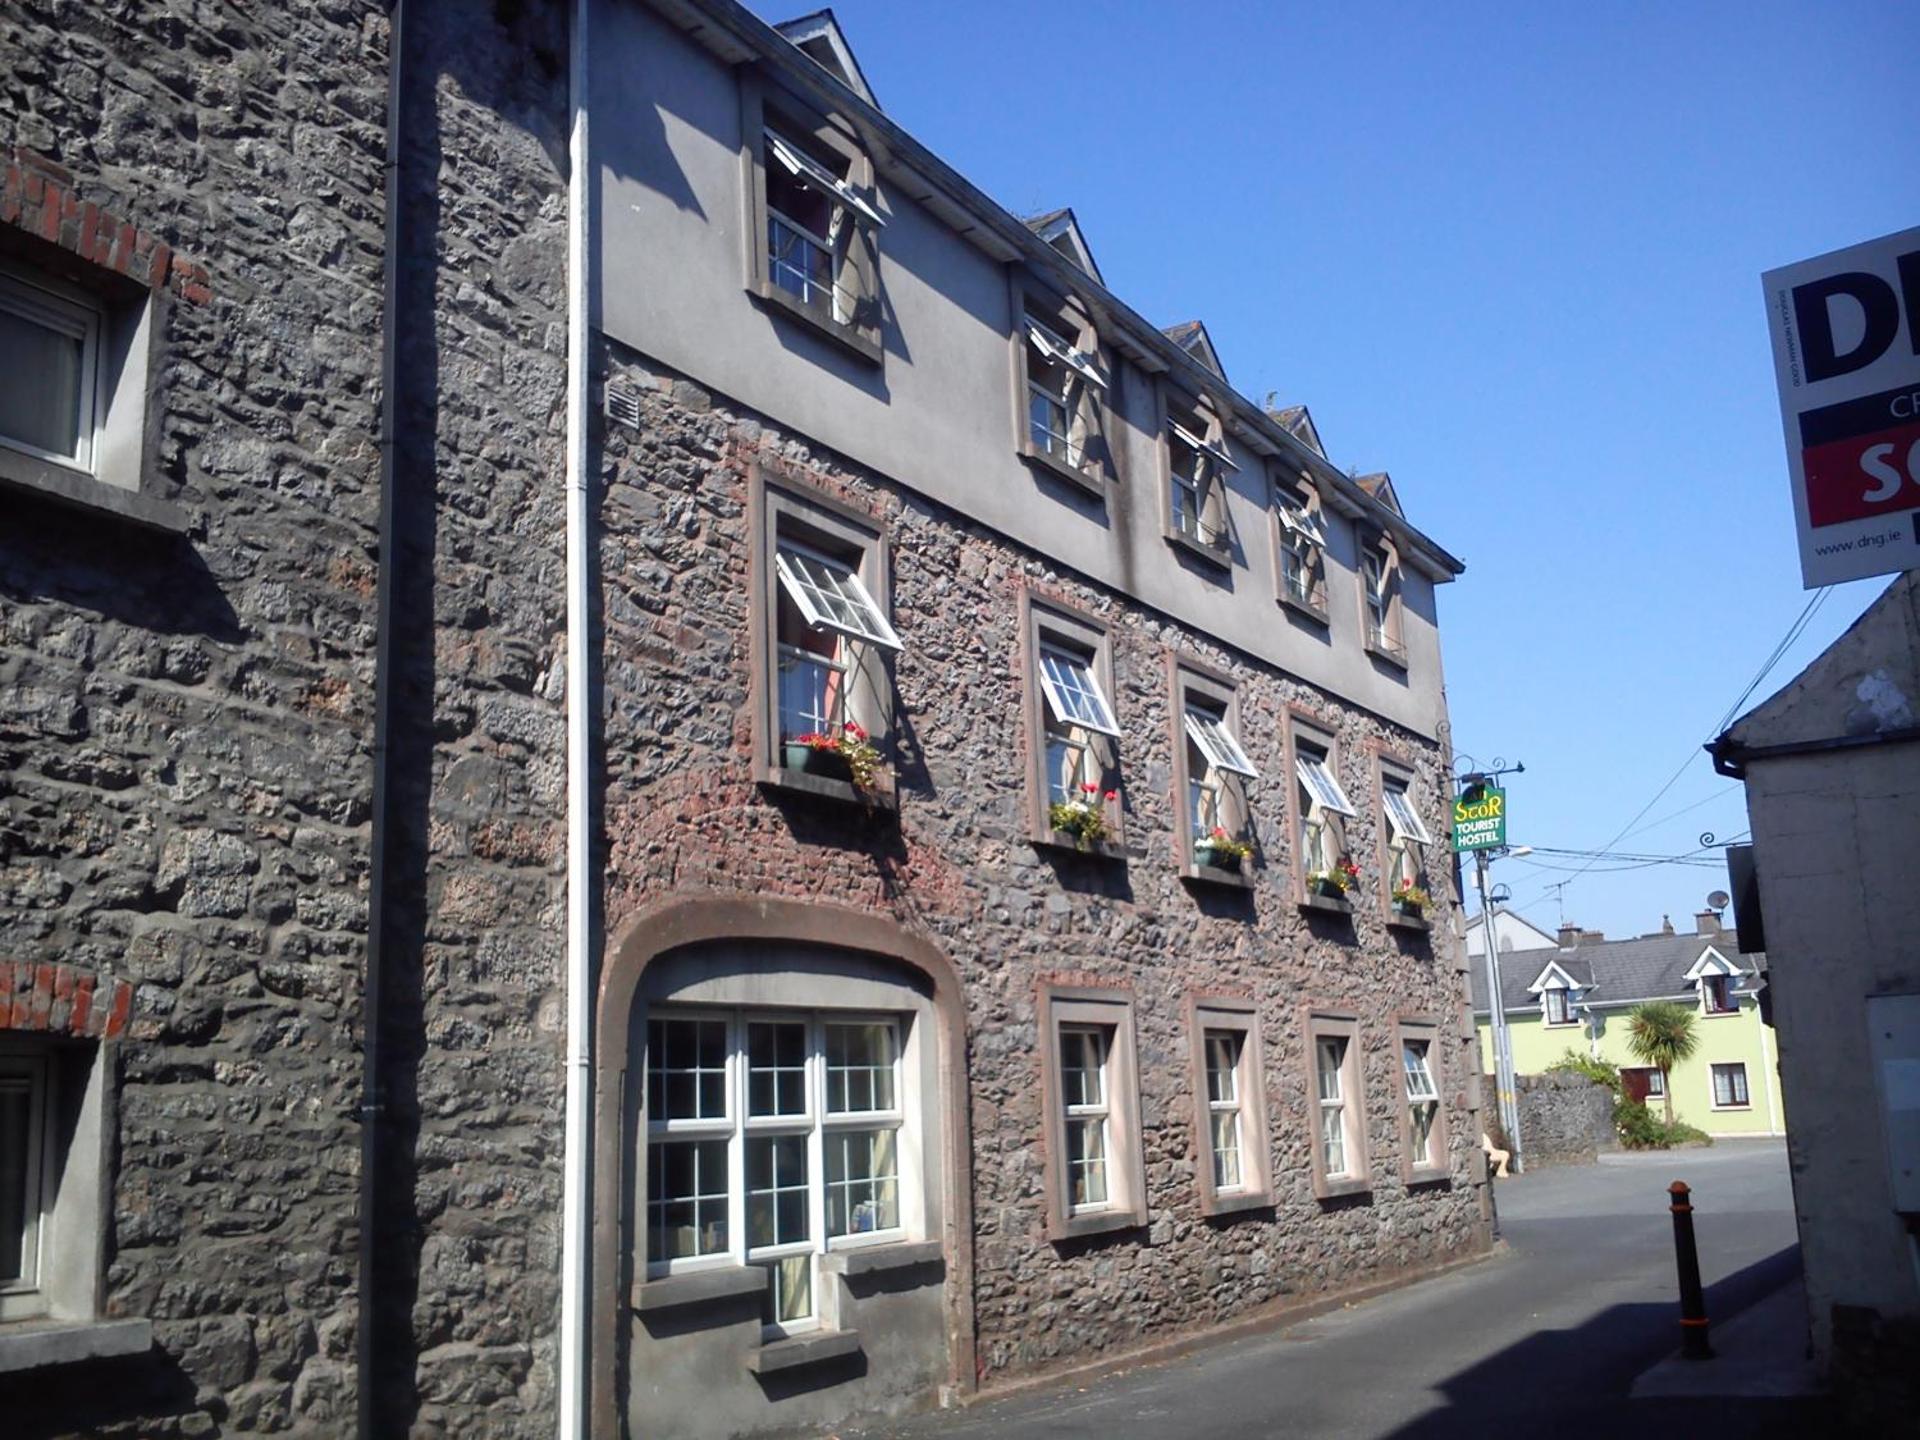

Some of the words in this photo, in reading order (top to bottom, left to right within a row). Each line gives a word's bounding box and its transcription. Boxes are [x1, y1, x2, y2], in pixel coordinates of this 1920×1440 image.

[1792, 250, 1920, 384] D
[1859, 438, 1920, 503] S
[1814, 529, 1902, 557] www.dng.ie
[1456, 817, 1501, 835] TOURIST
[1457, 831, 1500, 847] HOSTEL
